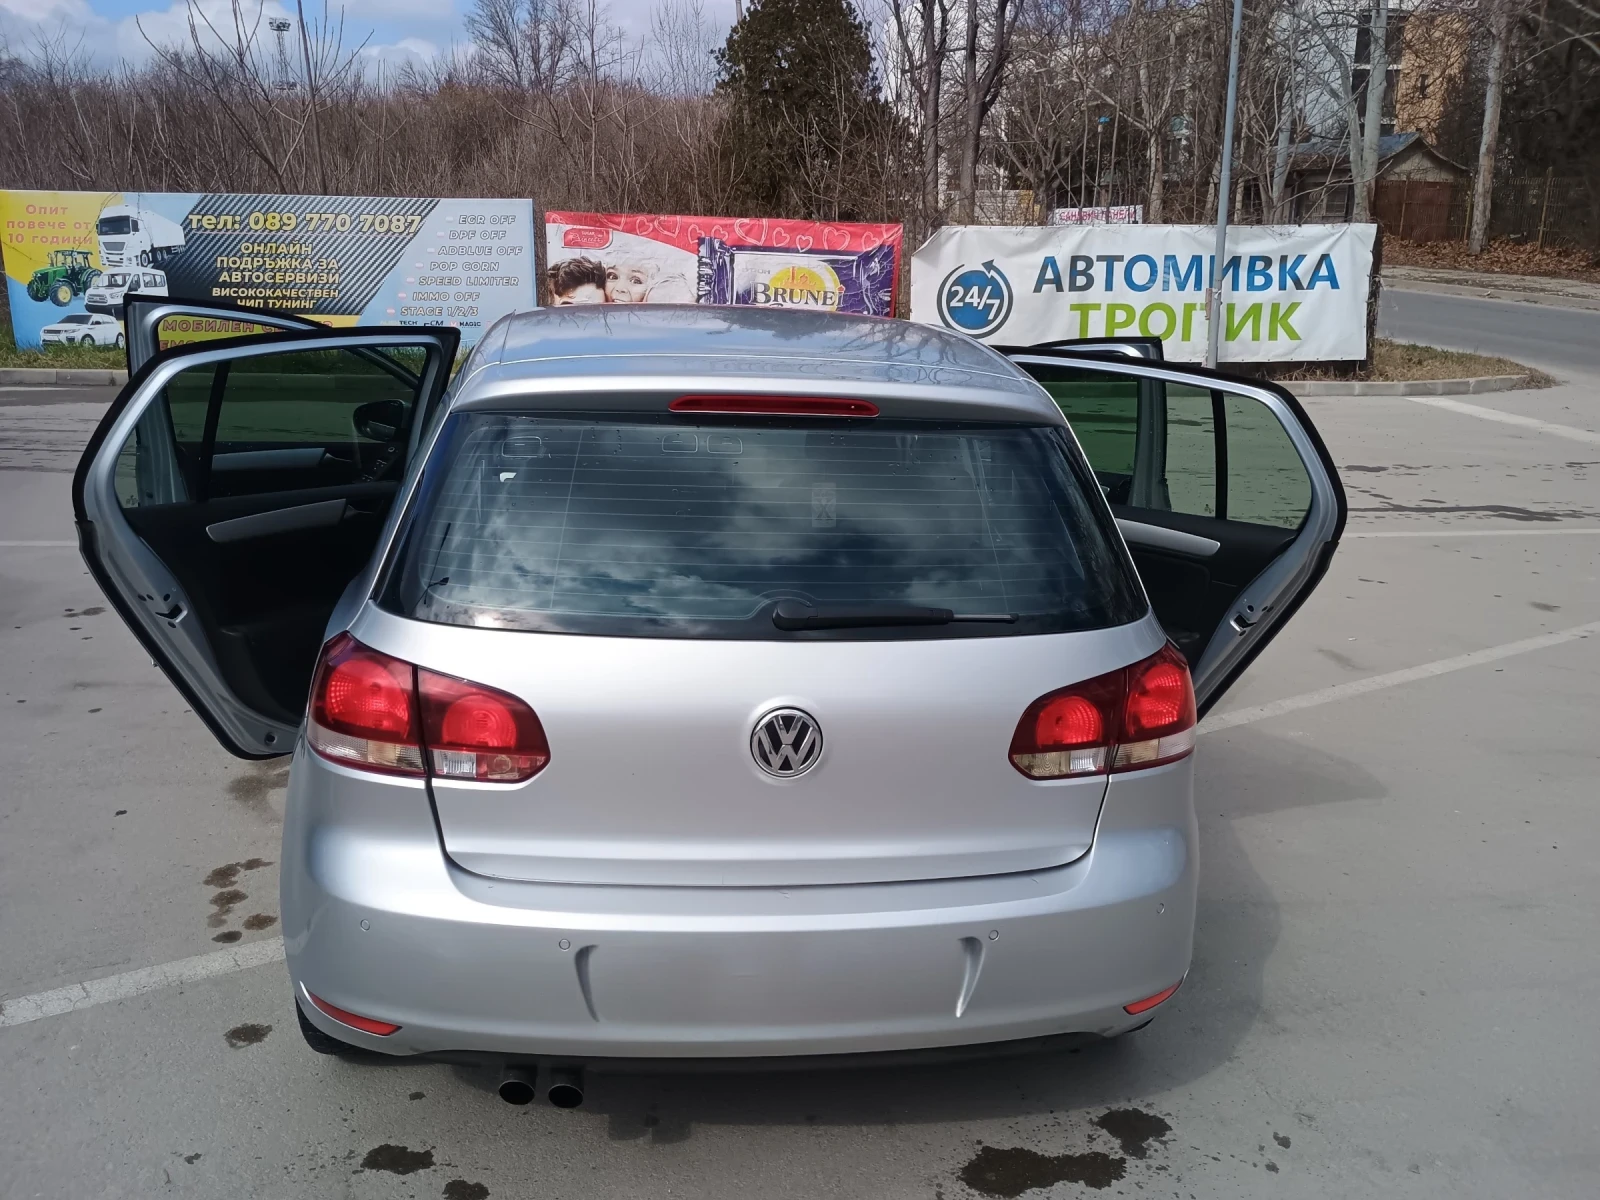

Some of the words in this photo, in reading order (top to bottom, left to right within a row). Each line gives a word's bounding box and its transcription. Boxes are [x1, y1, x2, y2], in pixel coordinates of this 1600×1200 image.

[26, 204, 68, 215] Опит
[6, 220, 66, 230] повече
[74, 221, 91, 230] от
[189, 214, 241, 229] тел:
[250, 212, 297, 231] 089
[305, 213, 350, 232] 770
[359, 214, 422, 233] 7087
[458, 215, 485, 225] EGR
[489, 215, 517, 225] OFF
[8, 233, 24, 243] 10
[32, 235, 93, 245] години
[448, 230, 476, 240] DPF
[479, 230, 507, 240] OFF
[240, 240, 313, 255] ОНЛАЙН
[437, 245, 493, 256] ADBLUE
[496, 246, 523, 256] OFF
[216, 256, 313, 270] ПОДРЪЖКА
[318, 258, 339, 270] ЗА
[429, 261, 458, 272] POP
[461, 261, 500, 272] CORN
[218, 271, 340, 284] АВТОСЕРВИЗИ
[1033, 253, 1341, 293] АВТОМИВКА
[418, 276, 462, 286] SPEED
[465, 277, 519, 287] LIMITER
[211, 287, 339, 298] ВИСОКОКАЧЕСТВЕН
[412, 291, 450, 302] IMMO
[453, 292, 481, 302] OFF
[267, 299, 317, 309] ТУНИНГ
[949, 285, 1001, 320] 24/7
[400, 306, 443, 317] STAGE
[446, 306, 479, 317] 1/2/3
[162, 319, 254, 332] МОБИЛЕН
